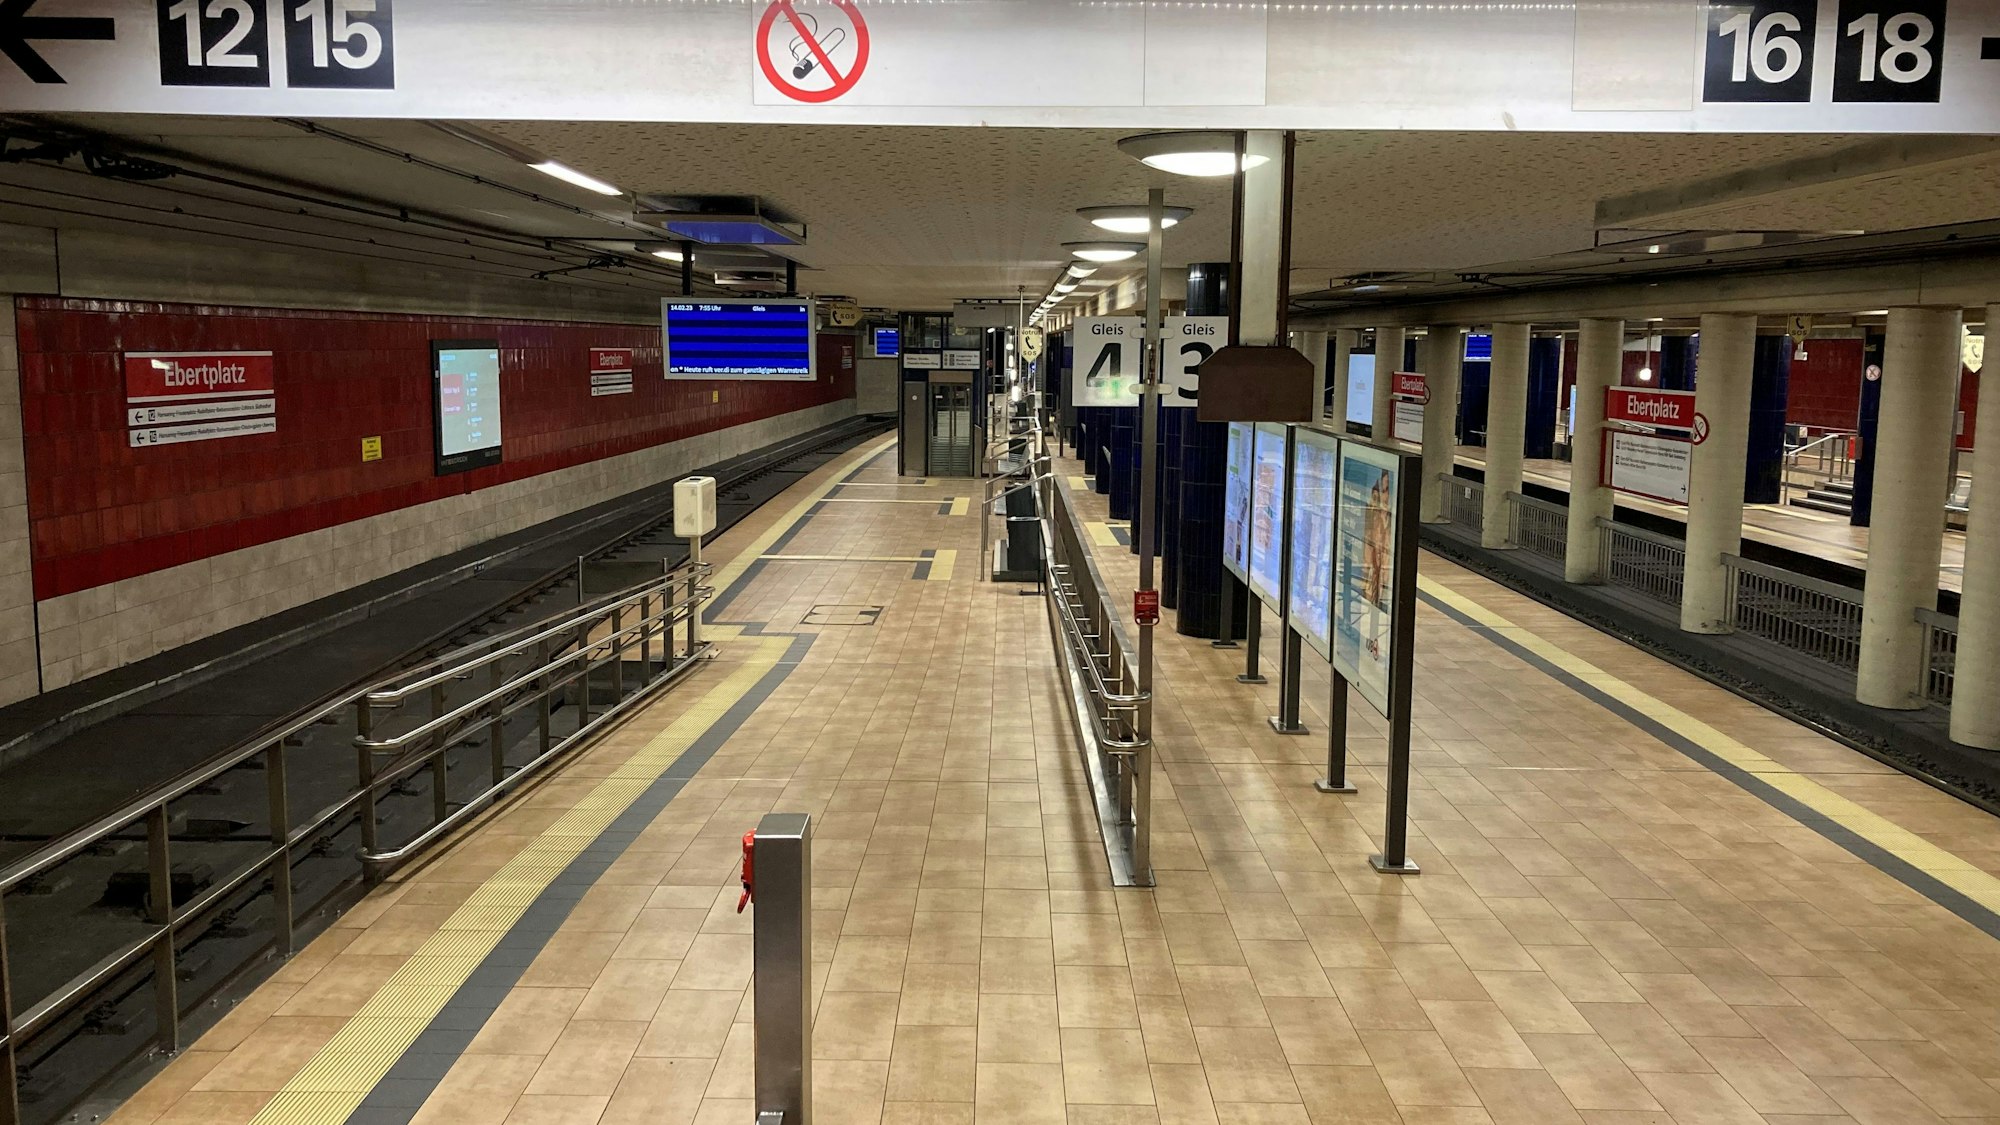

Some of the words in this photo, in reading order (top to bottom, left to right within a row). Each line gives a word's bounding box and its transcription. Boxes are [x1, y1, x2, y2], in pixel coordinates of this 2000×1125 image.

[169, 0, 258, 67] 12
[295, 0, 383, 69] 15
[1719, 11, 1802, 83] 16
[1847, 12, 1934, 83] 18
[670, 304, 693, 312] 14.02.23
[1092, 323, 1124, 336] Gleis
[1182, 323, 1215, 336] Gleis
[164, 360, 246, 390] Ebertplatz
[1086, 342, 1123, 399] 4
[1178, 341, 1214, 400] 3
[1627, 394, 1680, 421] Ebertplatz
